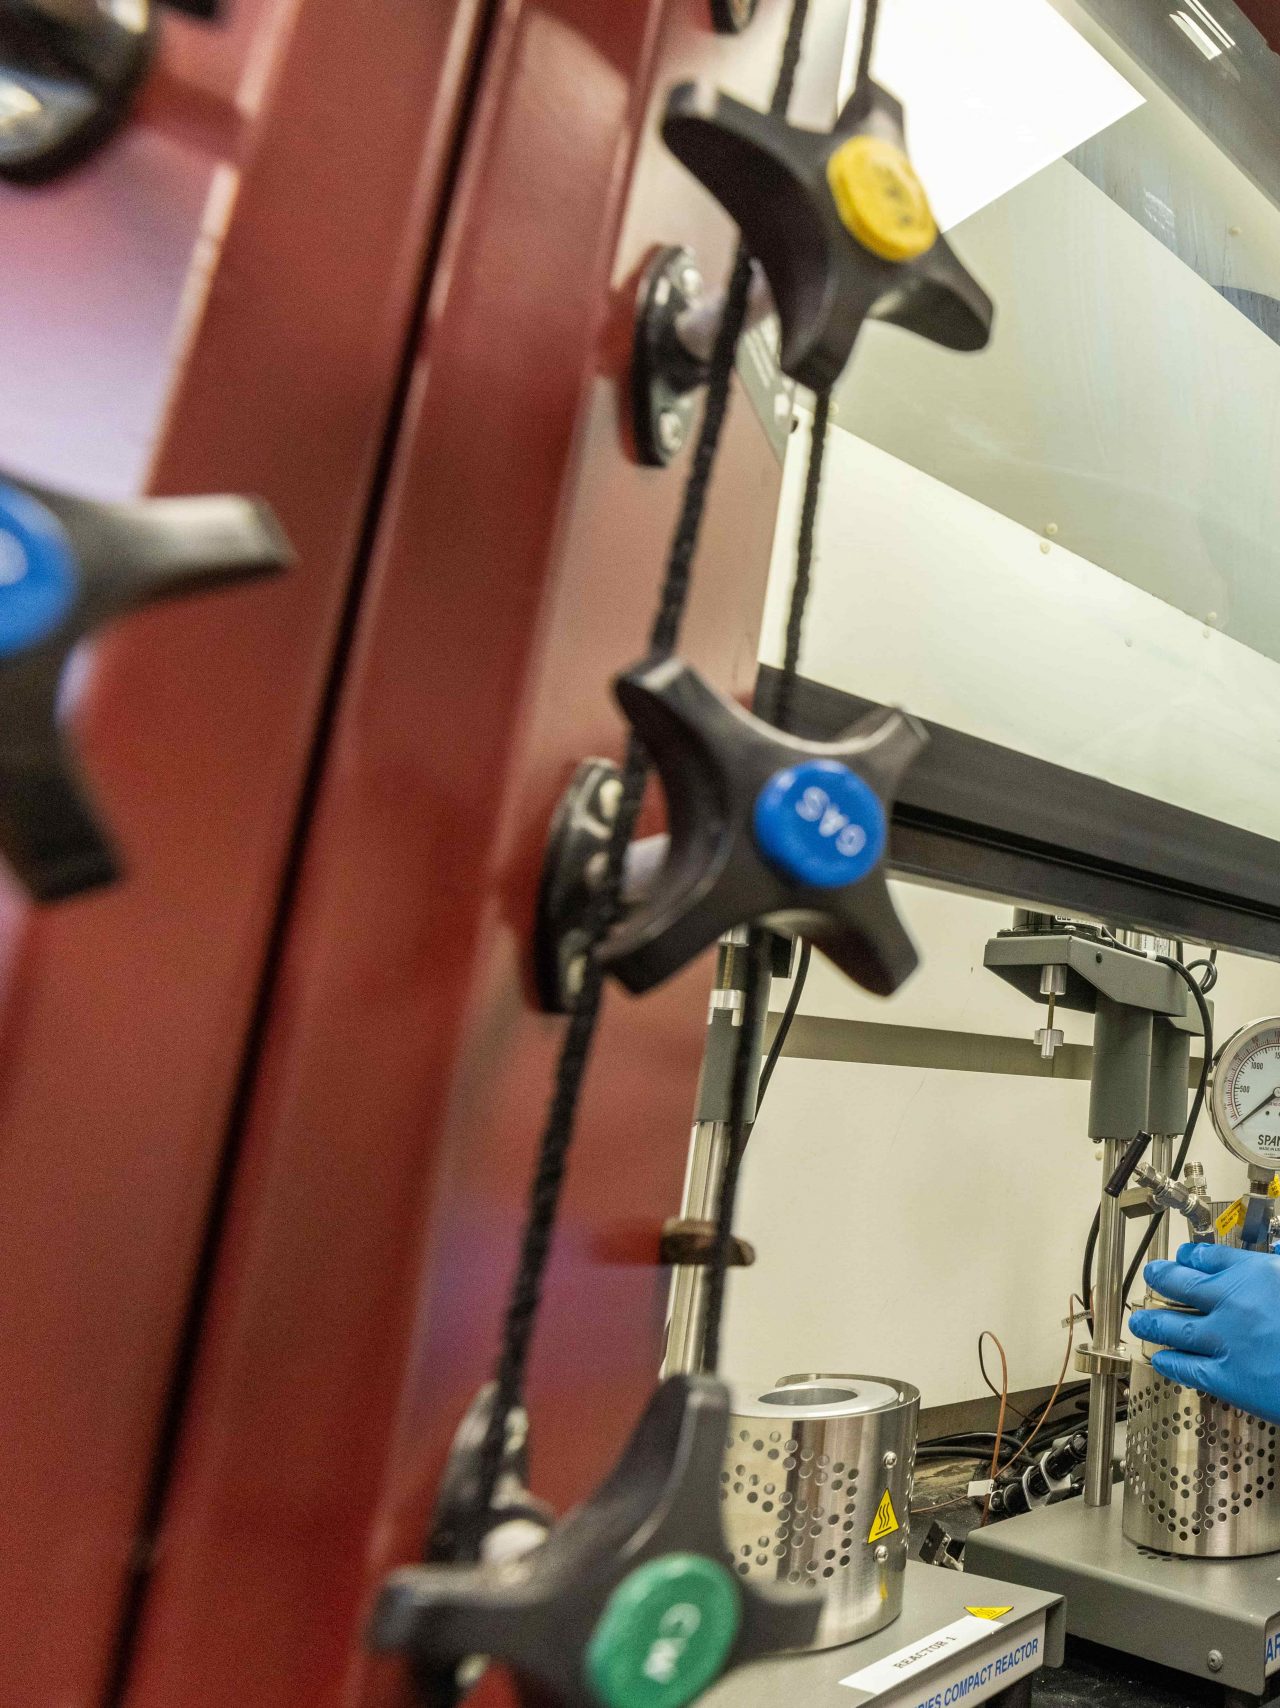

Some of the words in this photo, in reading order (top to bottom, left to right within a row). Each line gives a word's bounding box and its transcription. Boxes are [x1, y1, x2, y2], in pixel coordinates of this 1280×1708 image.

[795, 786, 867, 857] GAS
[1251, 1061, 1264, 1070] 1000
[1239, 1085, 1250, 1093] 500
[893, 1640, 946, 1669] REACTOR
[944, 1663, 993, 1706] COMPACT
[995, 1638, 1039, 1677] REACTOR
